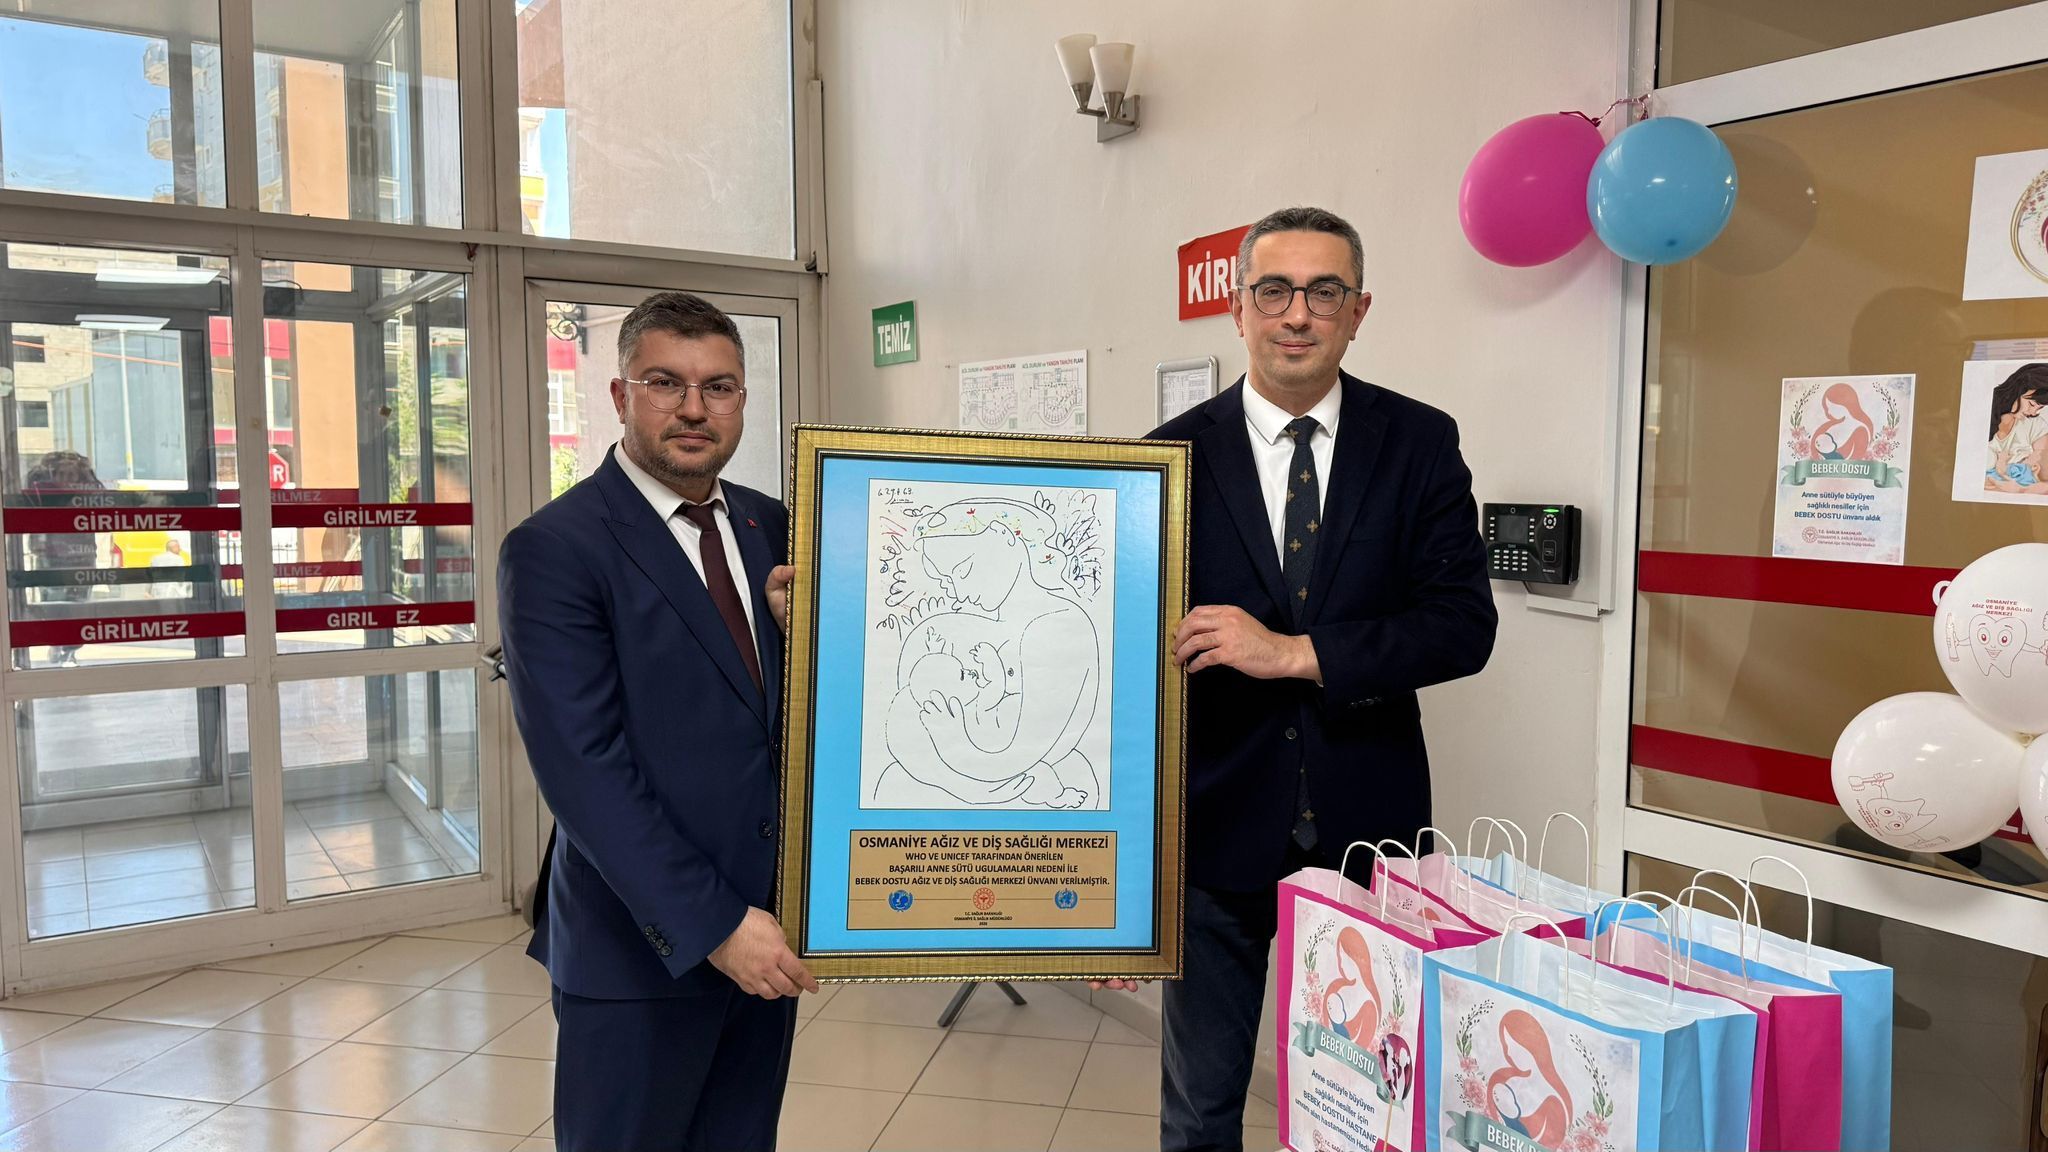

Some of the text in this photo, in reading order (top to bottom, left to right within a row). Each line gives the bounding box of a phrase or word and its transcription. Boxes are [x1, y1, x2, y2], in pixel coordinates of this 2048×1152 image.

[1188, 250, 1238, 304] KİRL
[877, 314, 911, 355] TEMİZ
[1812, 463, 1870, 475] BEBEK DOSTU
[1820, 492, 1844, 501] sütüyle
[74, 511, 182, 531] GİRİLMEZ
[324, 506, 417, 526] GİRİLMEZ
[74, 571, 117, 584] ÇIKIŞ
[80, 620, 189, 641] GİRİLMEZ
[859, 834, 1108, 850] OSMANİYE AĞIZ VE DİŞ SAĞLIĞI MERKEZİ
[906, 852, 926, 860] WHO
[928, 852, 939, 860] VE
[941, 852, 970, 860] UNICEF
[1024, 852, 1063, 861] ÖNERİLEN
[889, 864, 1078, 874] BAŞARILI ANNE SÜTÜ UGULAMALARI NEDENİ İLE
[912, 876, 930, 885] AĞIZ
[944, 876, 957, 887] DİŞ
[960, 876, 989, 885] SAĞLIĞI
[992, 877, 1026, 885] MERKEZİ
[1028, 876, 1058, 885] ÜNVANI
[1060, 876, 1110, 887] VERİLMİŞTİR.
[1320, 1032, 1374, 1075] BEBEK DOSTU
[1312, 1069, 1375, 1114] Anne sütüyle büyüyen
[1303, 1090, 1377, 1144] BEBEK DOSTU HASTANE
[1335, 1100, 1357, 1118] nesiller
[1357, 1112, 1369, 1126] için
[1310, 1109, 1321, 1121] alan
[1321, 1117, 1356, 1144] hastanemizin
[1487, 1124, 1524, 1152] BEBEK
